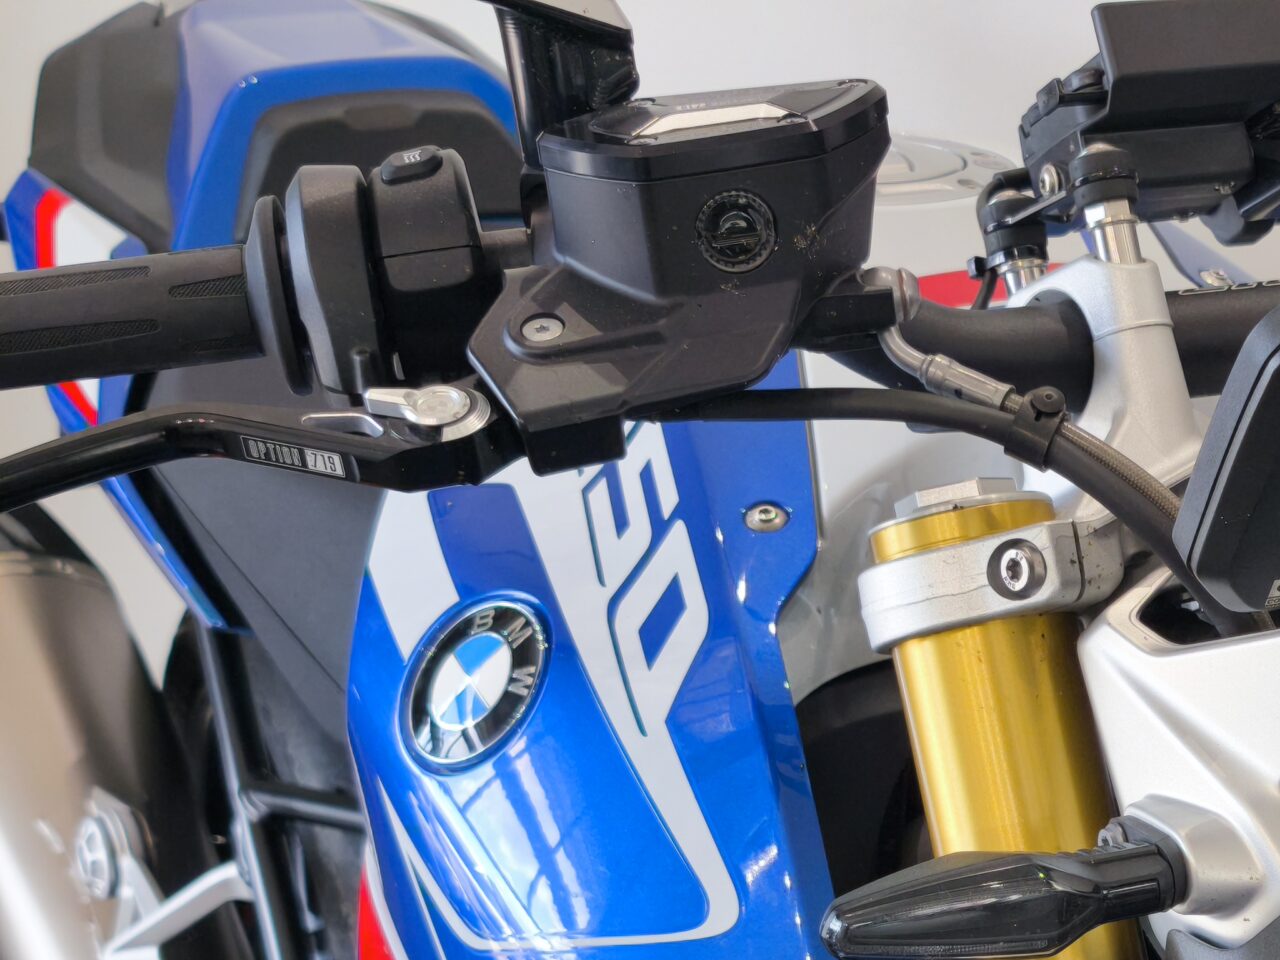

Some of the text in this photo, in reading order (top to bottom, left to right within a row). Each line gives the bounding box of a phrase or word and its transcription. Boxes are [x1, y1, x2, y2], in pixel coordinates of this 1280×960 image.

[247, 439, 338, 473] OPTION 719
[580, 421, 709, 735] 50
[470, 608, 537, 697] BMW
